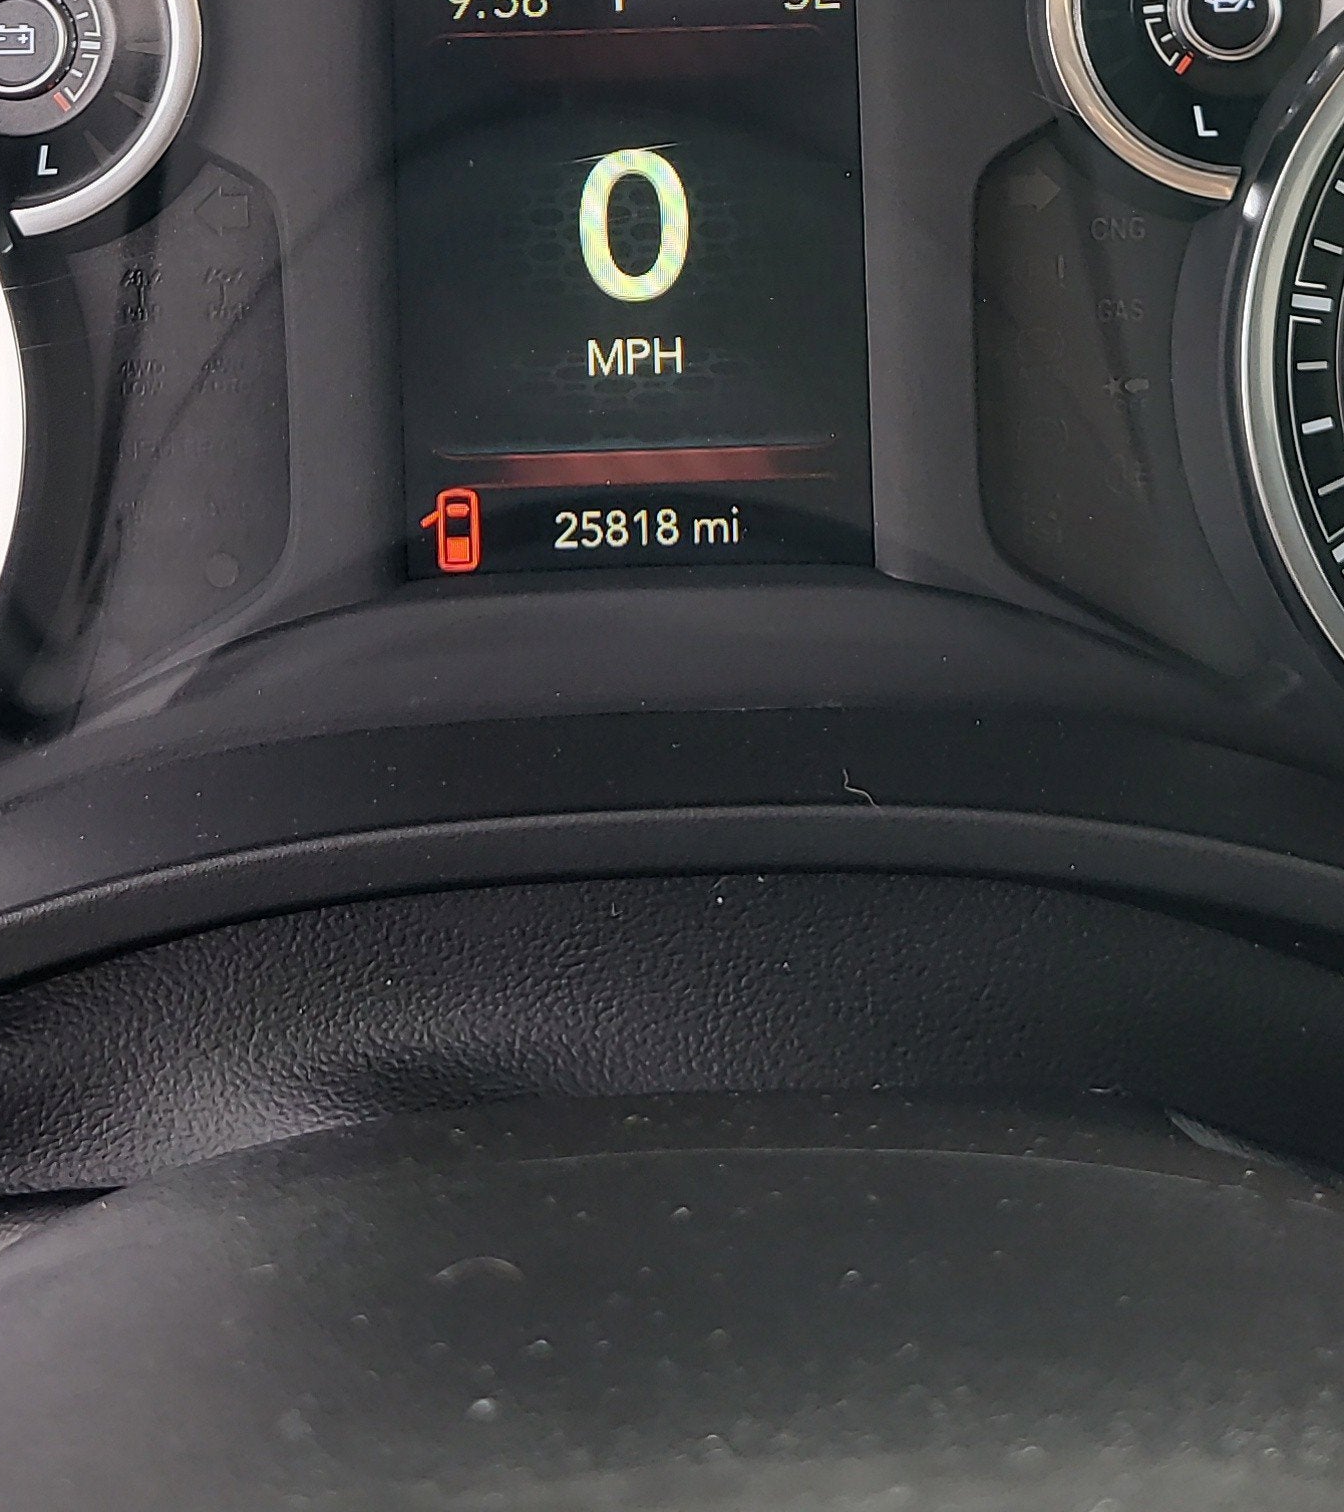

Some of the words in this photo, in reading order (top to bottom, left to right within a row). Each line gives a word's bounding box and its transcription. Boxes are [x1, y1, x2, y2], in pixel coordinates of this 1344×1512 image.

[1194, 106, 1218, 136] L
[38, 145, 58, 175] L
[579, 148, 689, 302] 0
[588, 337, 682, 376] MPH
[555, 509, 679, 549] 25818
[694, 506, 738, 544] mi
